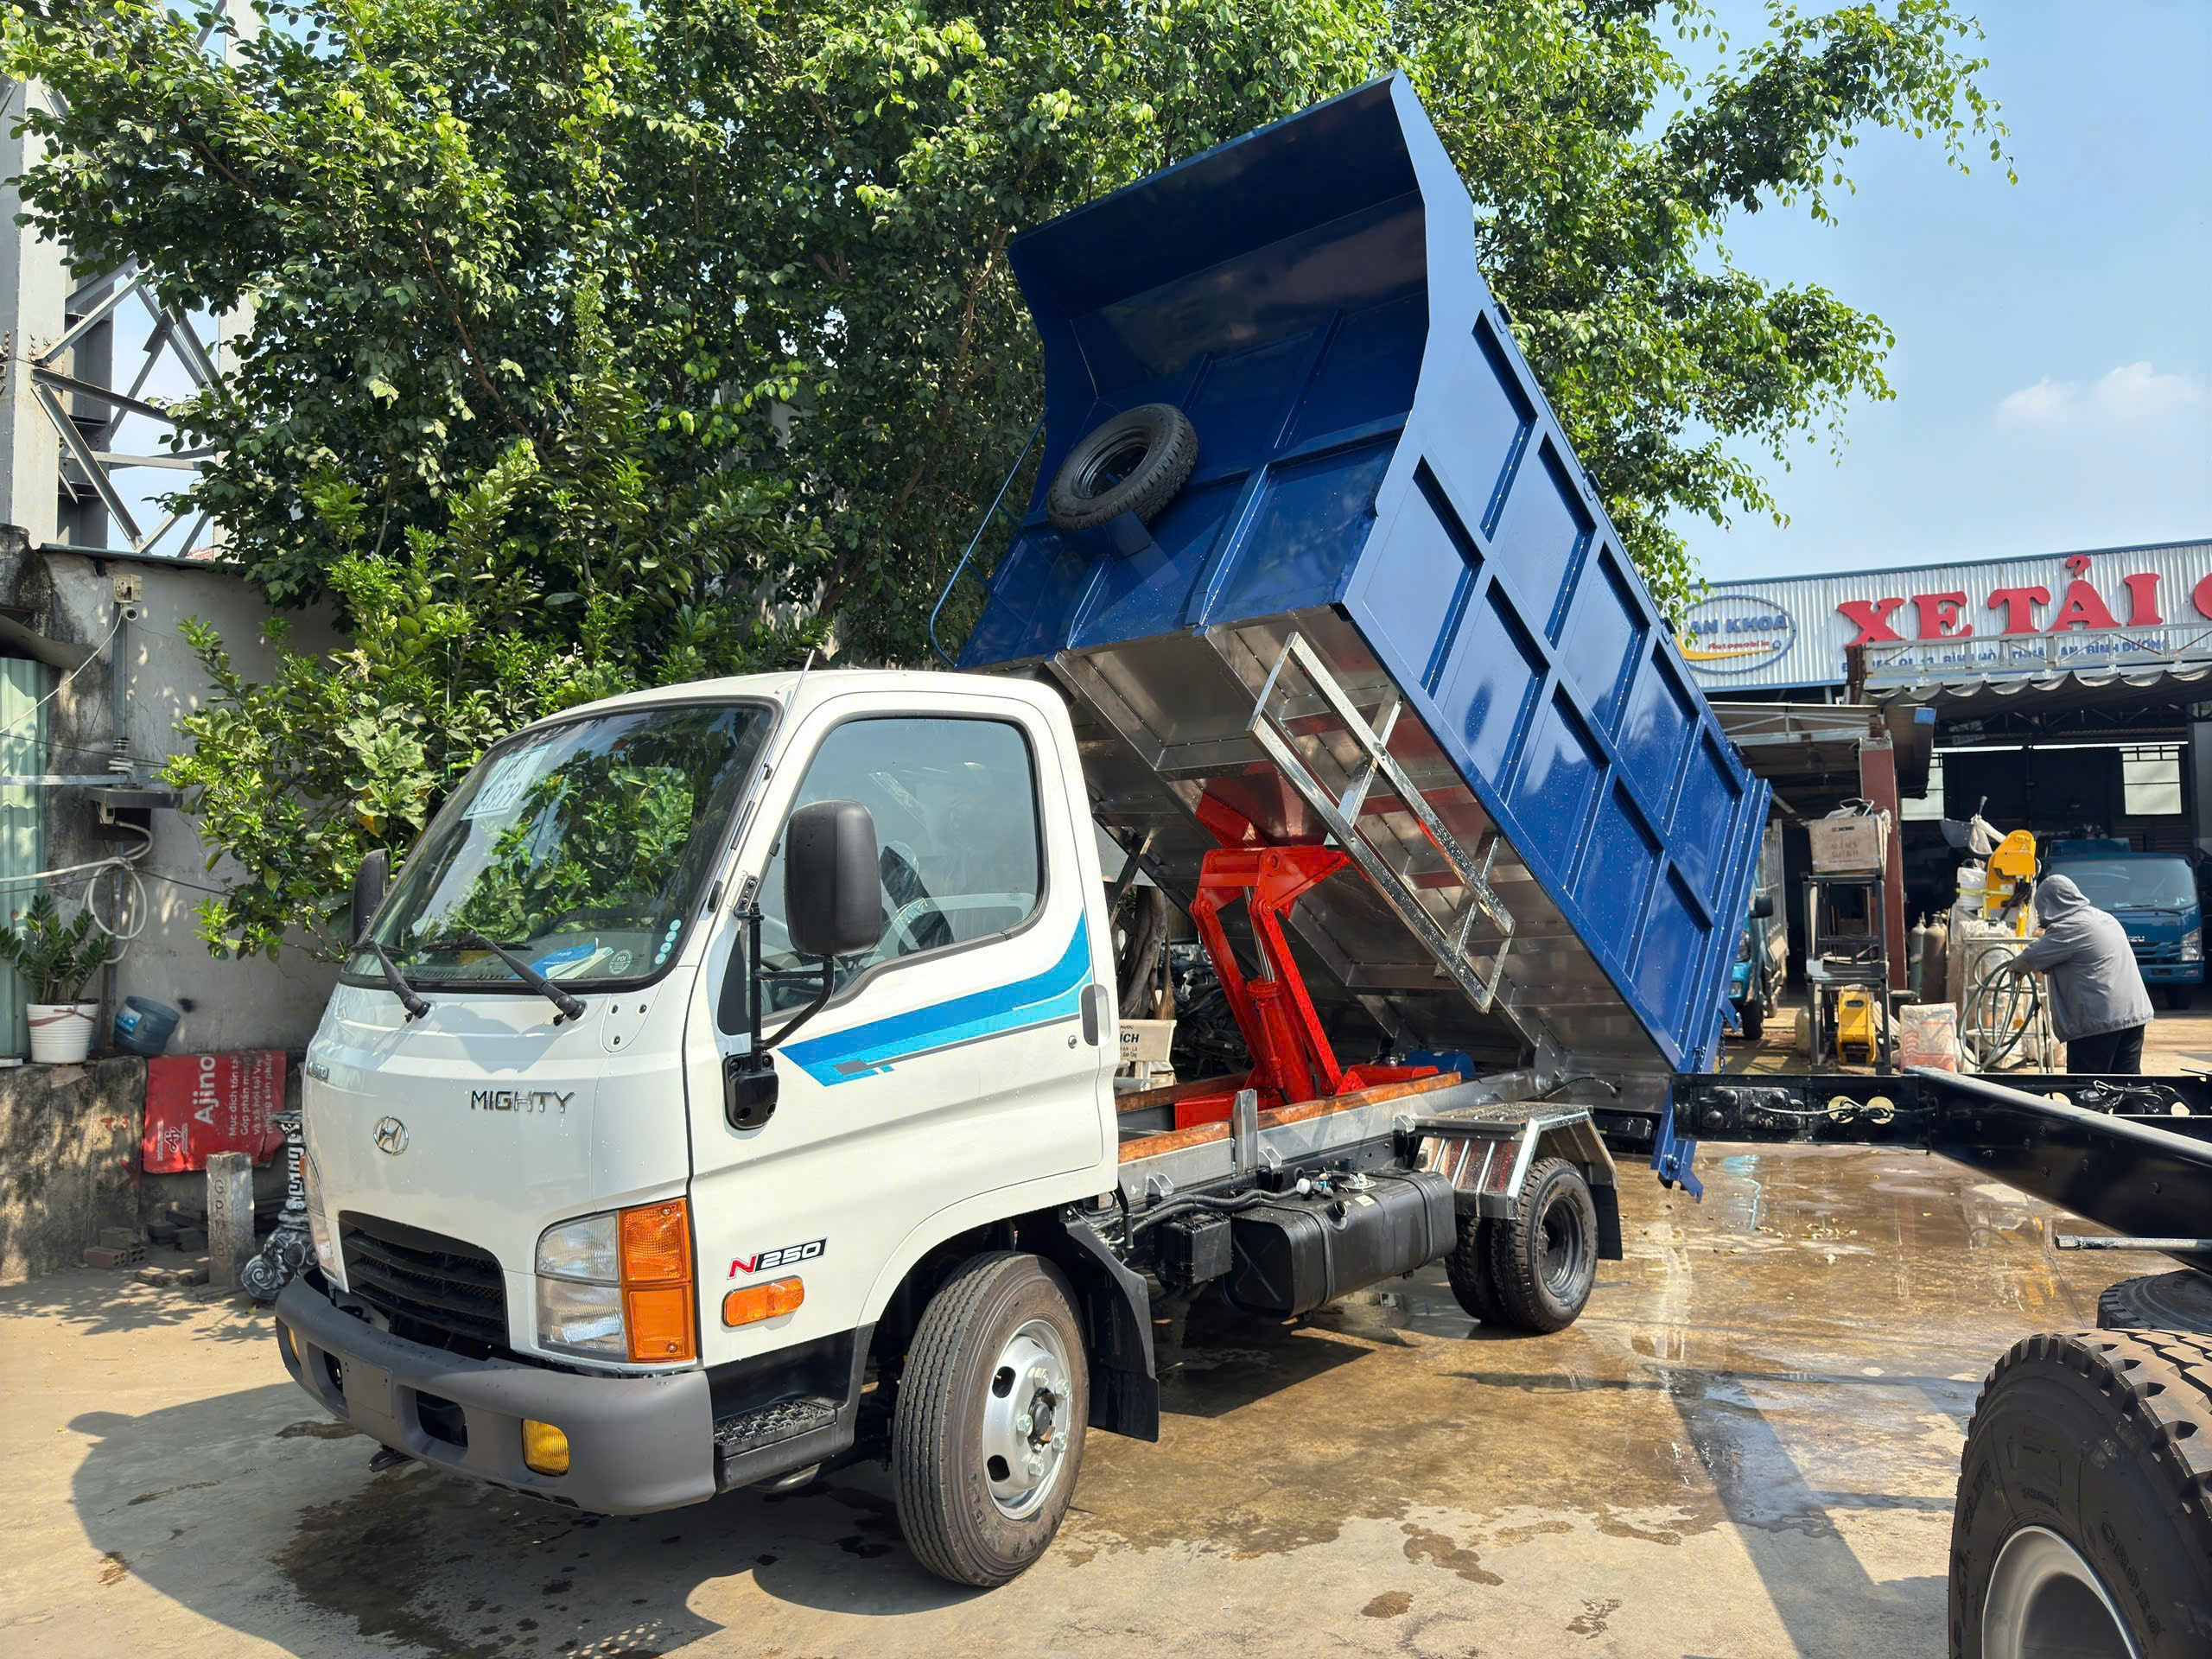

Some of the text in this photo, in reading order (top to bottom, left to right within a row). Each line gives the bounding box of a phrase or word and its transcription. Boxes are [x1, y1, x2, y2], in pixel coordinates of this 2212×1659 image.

[1837, 591, 1974, 648] XE
[1988, 554, 2164, 635] TẢI
[1726, 615, 1788, 633] KHOA
[193, 1056, 219, 1125] Ajino
[471, 1090, 576, 1113] MIGHTY
[728, 1242, 822, 1279] N250
